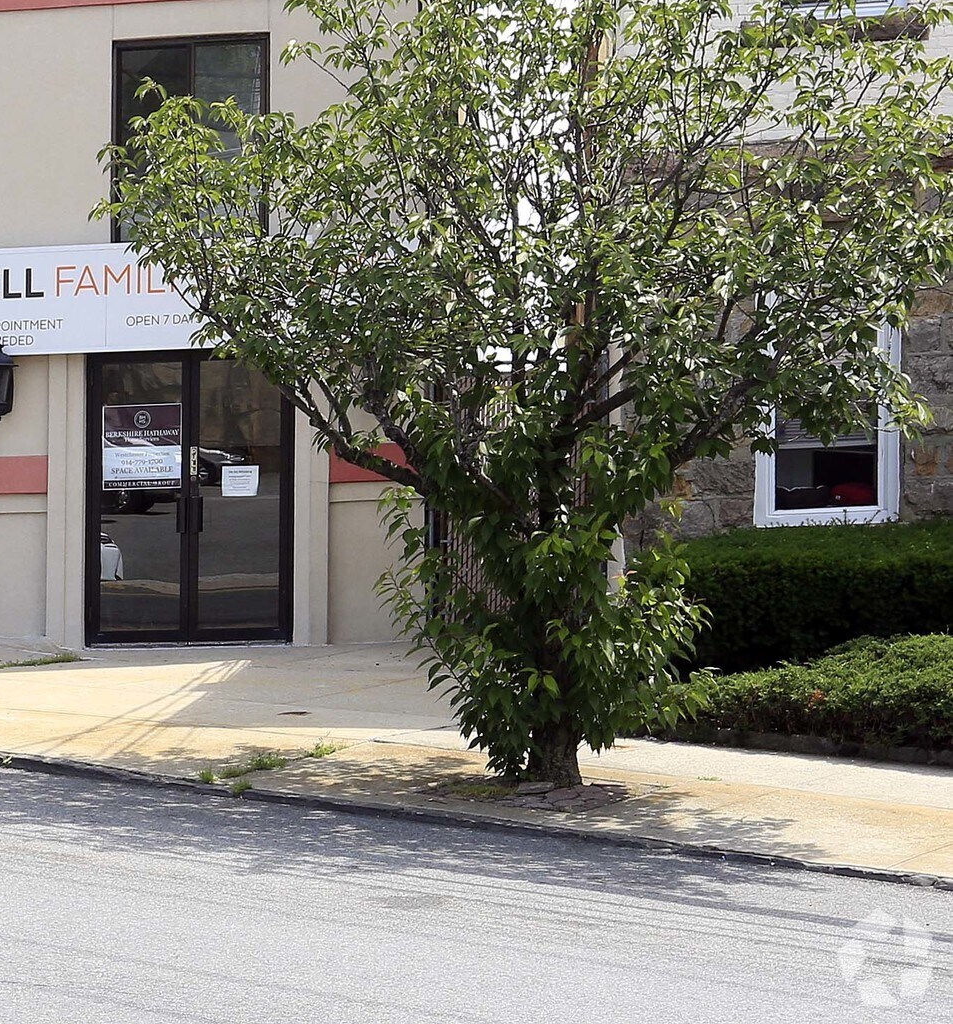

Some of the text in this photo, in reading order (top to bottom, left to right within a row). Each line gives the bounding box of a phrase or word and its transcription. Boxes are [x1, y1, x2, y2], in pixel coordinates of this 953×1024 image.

[125, 314, 160, 326] OPEN
[163, 314, 170, 325] 7
[105, 428, 180, 438] BERKSHIRE HATHAWAY
[110, 466, 134, 475] SPACE
